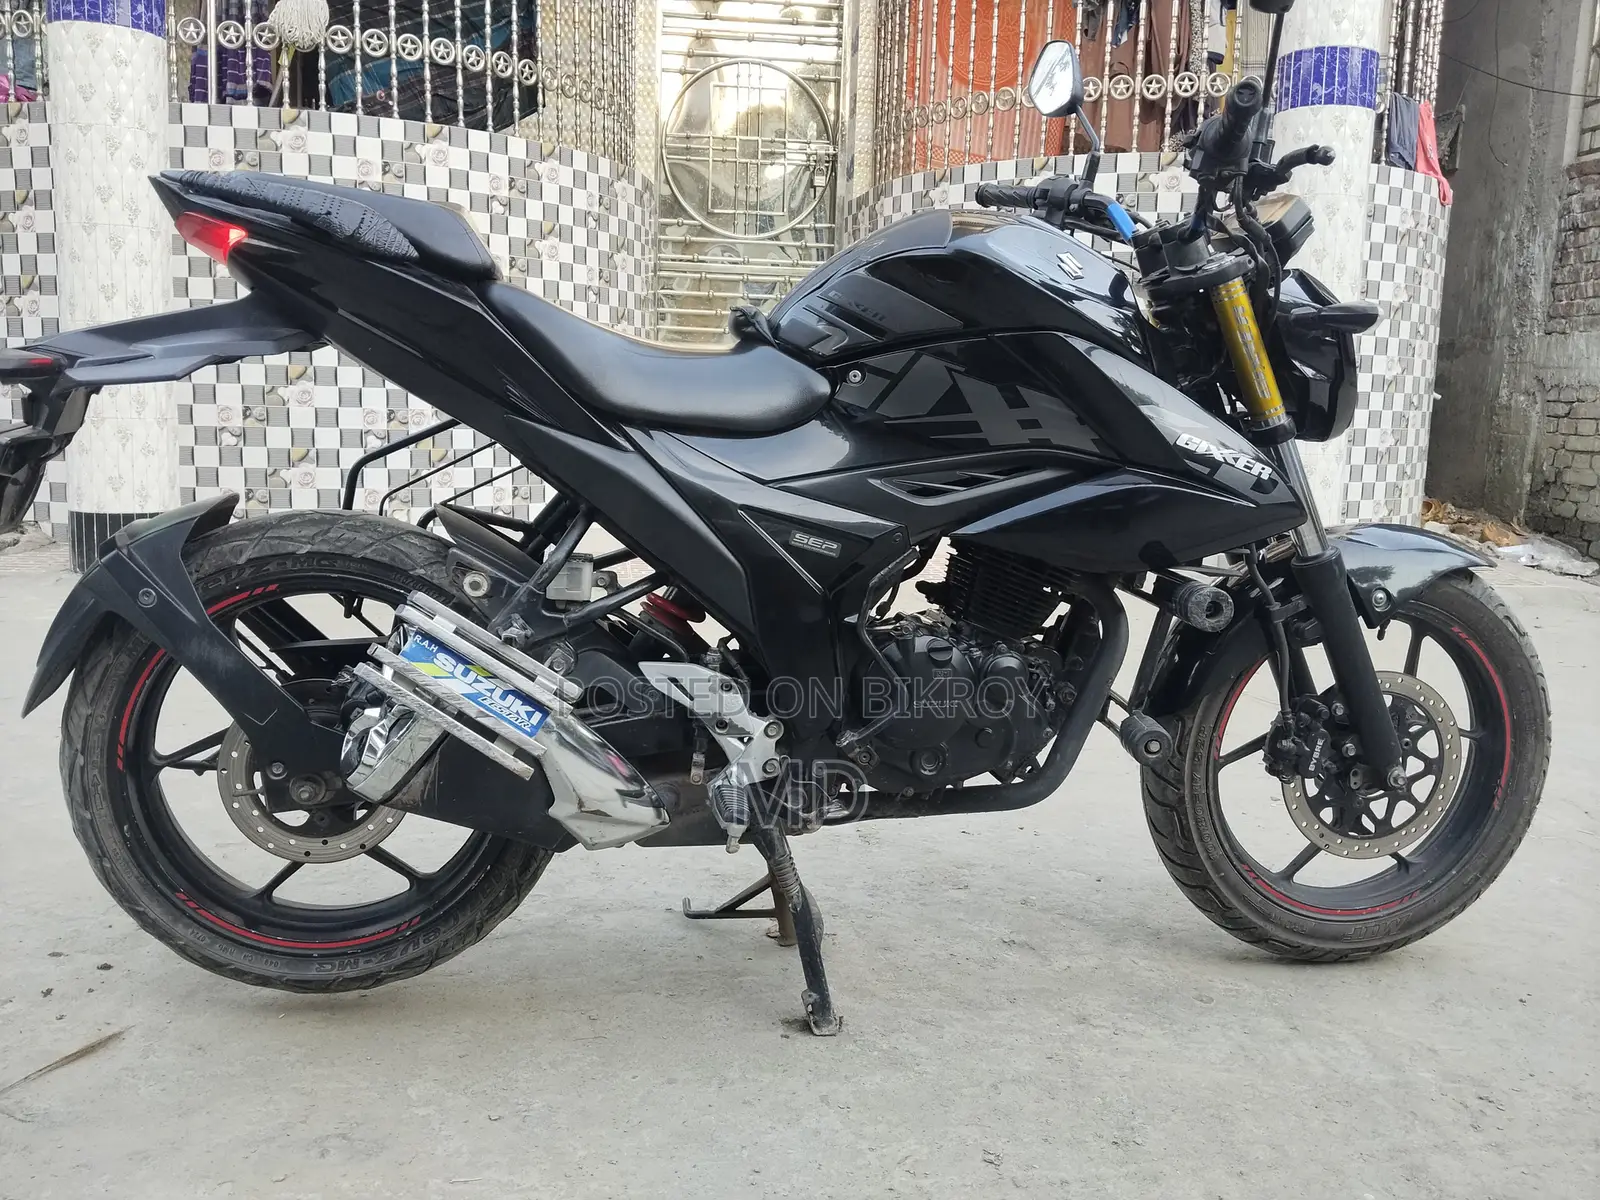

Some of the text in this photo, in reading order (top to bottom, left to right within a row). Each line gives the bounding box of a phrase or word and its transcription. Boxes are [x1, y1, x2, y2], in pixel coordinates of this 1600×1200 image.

[1176, 433, 1273, 480] GIXXER
[793, 533, 838, 549] SEP
[414, 634, 439, 653] R.A.H
[433, 652, 543, 726] SUZUKI
[913, 699, 958, 709] SUZUKI
[1308, 738, 1325, 771] BYBRE
